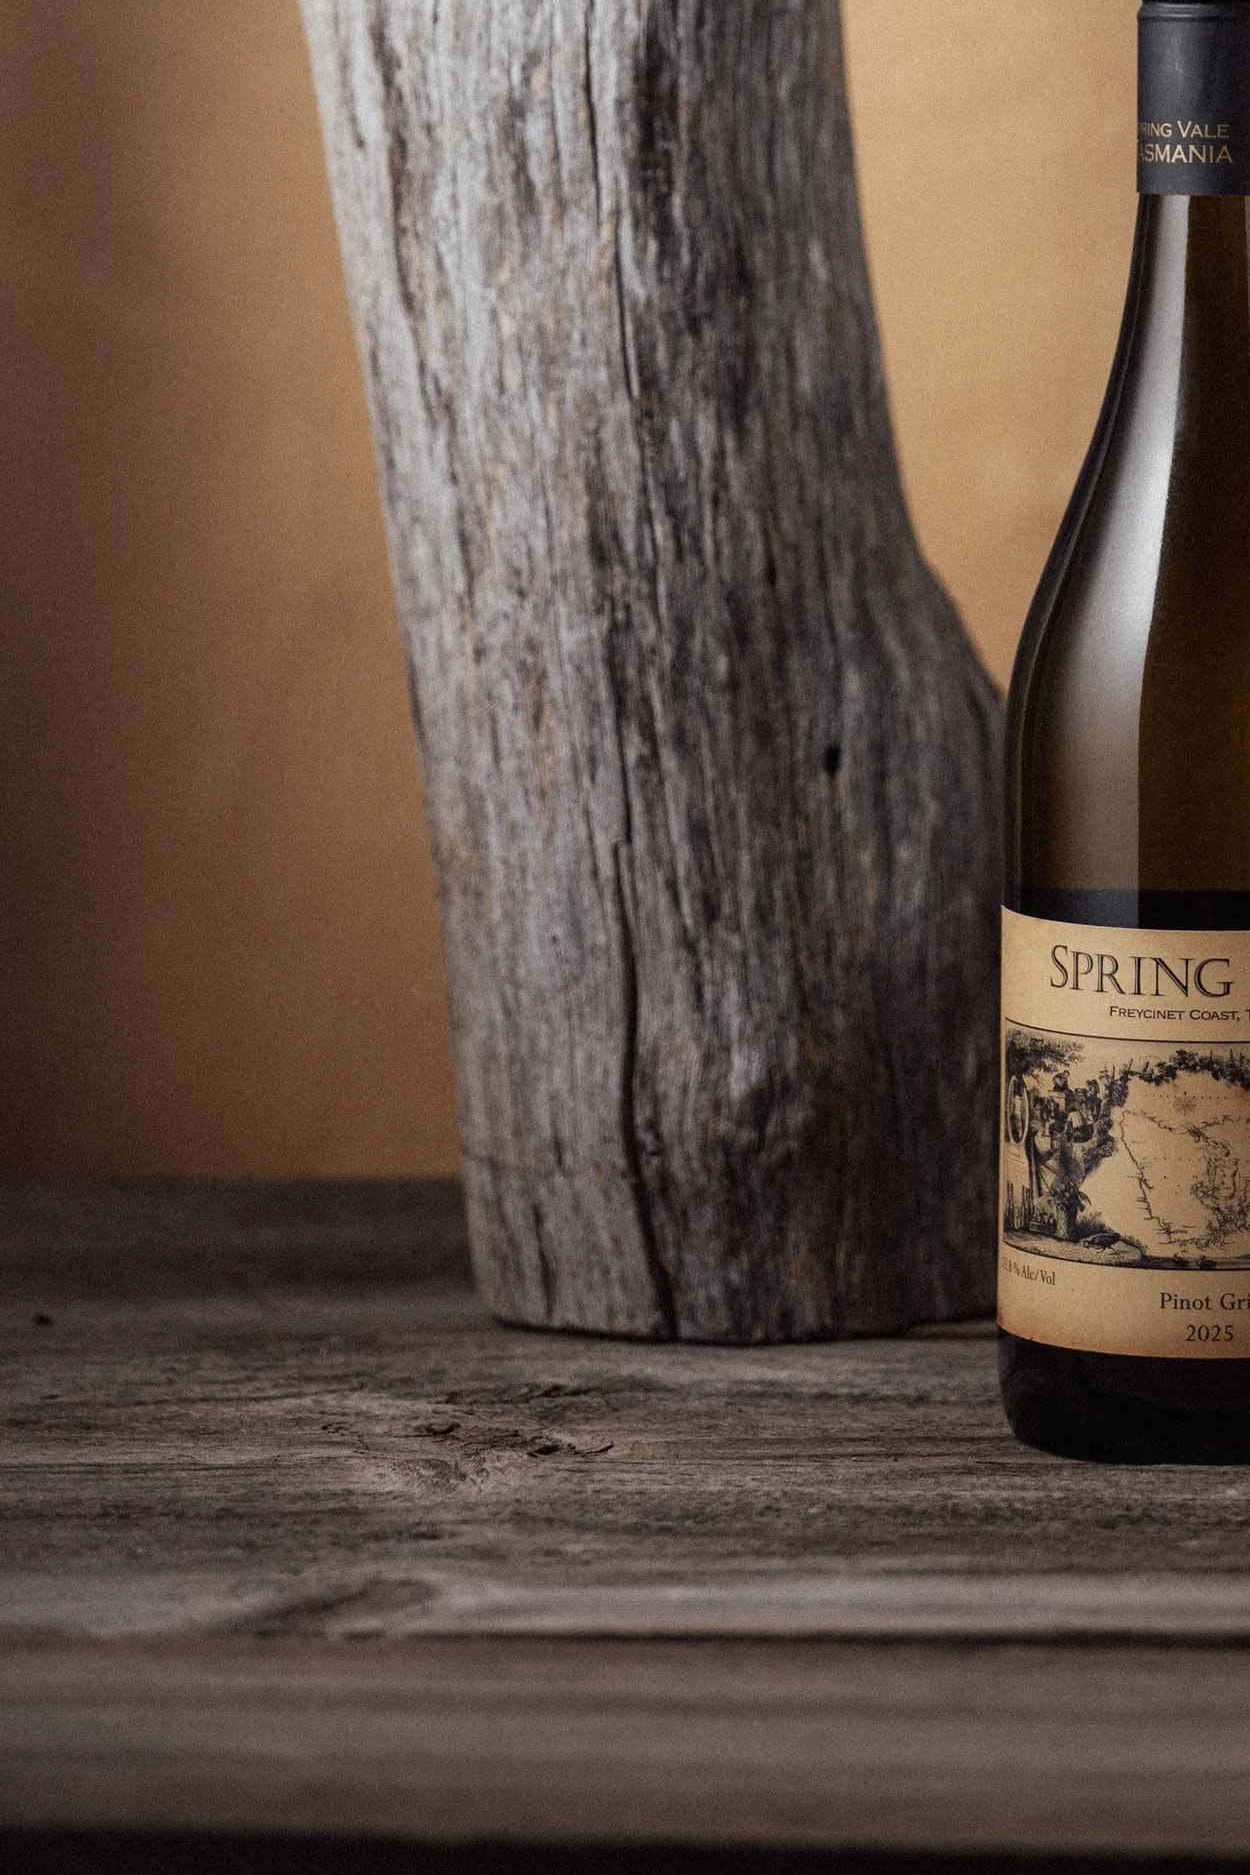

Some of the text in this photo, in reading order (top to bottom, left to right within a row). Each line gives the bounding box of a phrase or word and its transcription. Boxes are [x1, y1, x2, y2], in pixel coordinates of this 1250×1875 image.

[1176, 120, 1229, 138] VALE
[1050, 944, 1234, 998] SPRING
[1109, 1005, 1185, 1020] FREYCINET
[1189, 1009, 1240, 1022] COAST,
[1160, 1292, 1212, 1310] Pinot
[1185, 1324, 1234, 1342] 2025
